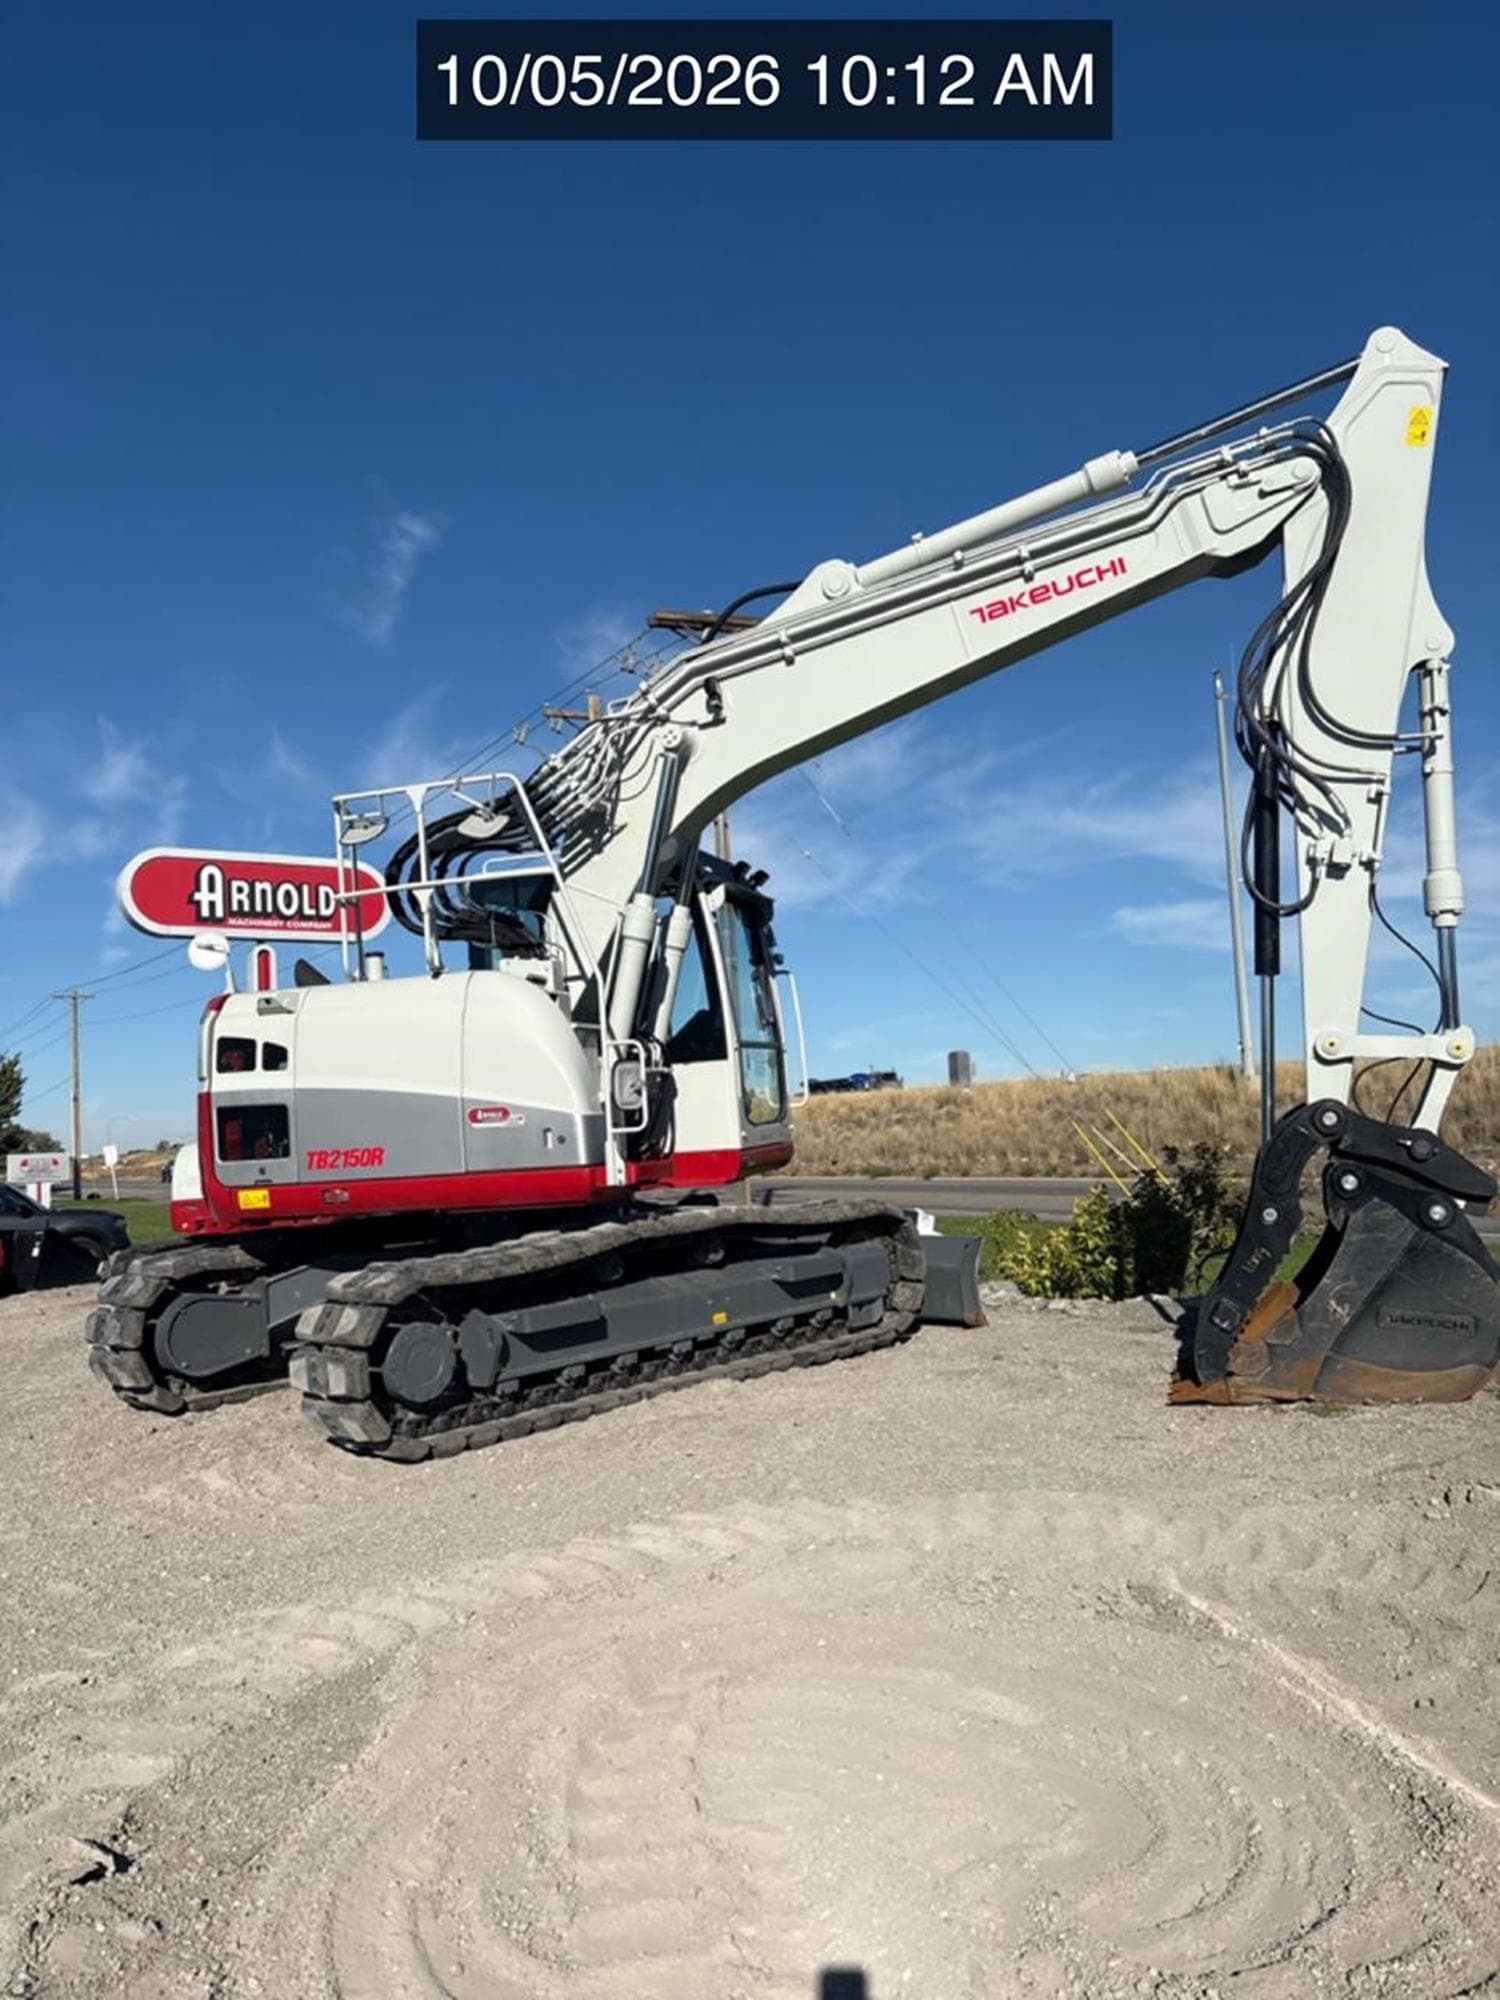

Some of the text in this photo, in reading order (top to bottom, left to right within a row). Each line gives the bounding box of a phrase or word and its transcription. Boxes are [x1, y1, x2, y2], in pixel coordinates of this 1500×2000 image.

[969, 557, 1127, 624] TAKEUCHI
[192, 864, 337, 919] ARNOLD
[306, 1146, 385, 1170] TB2150R
